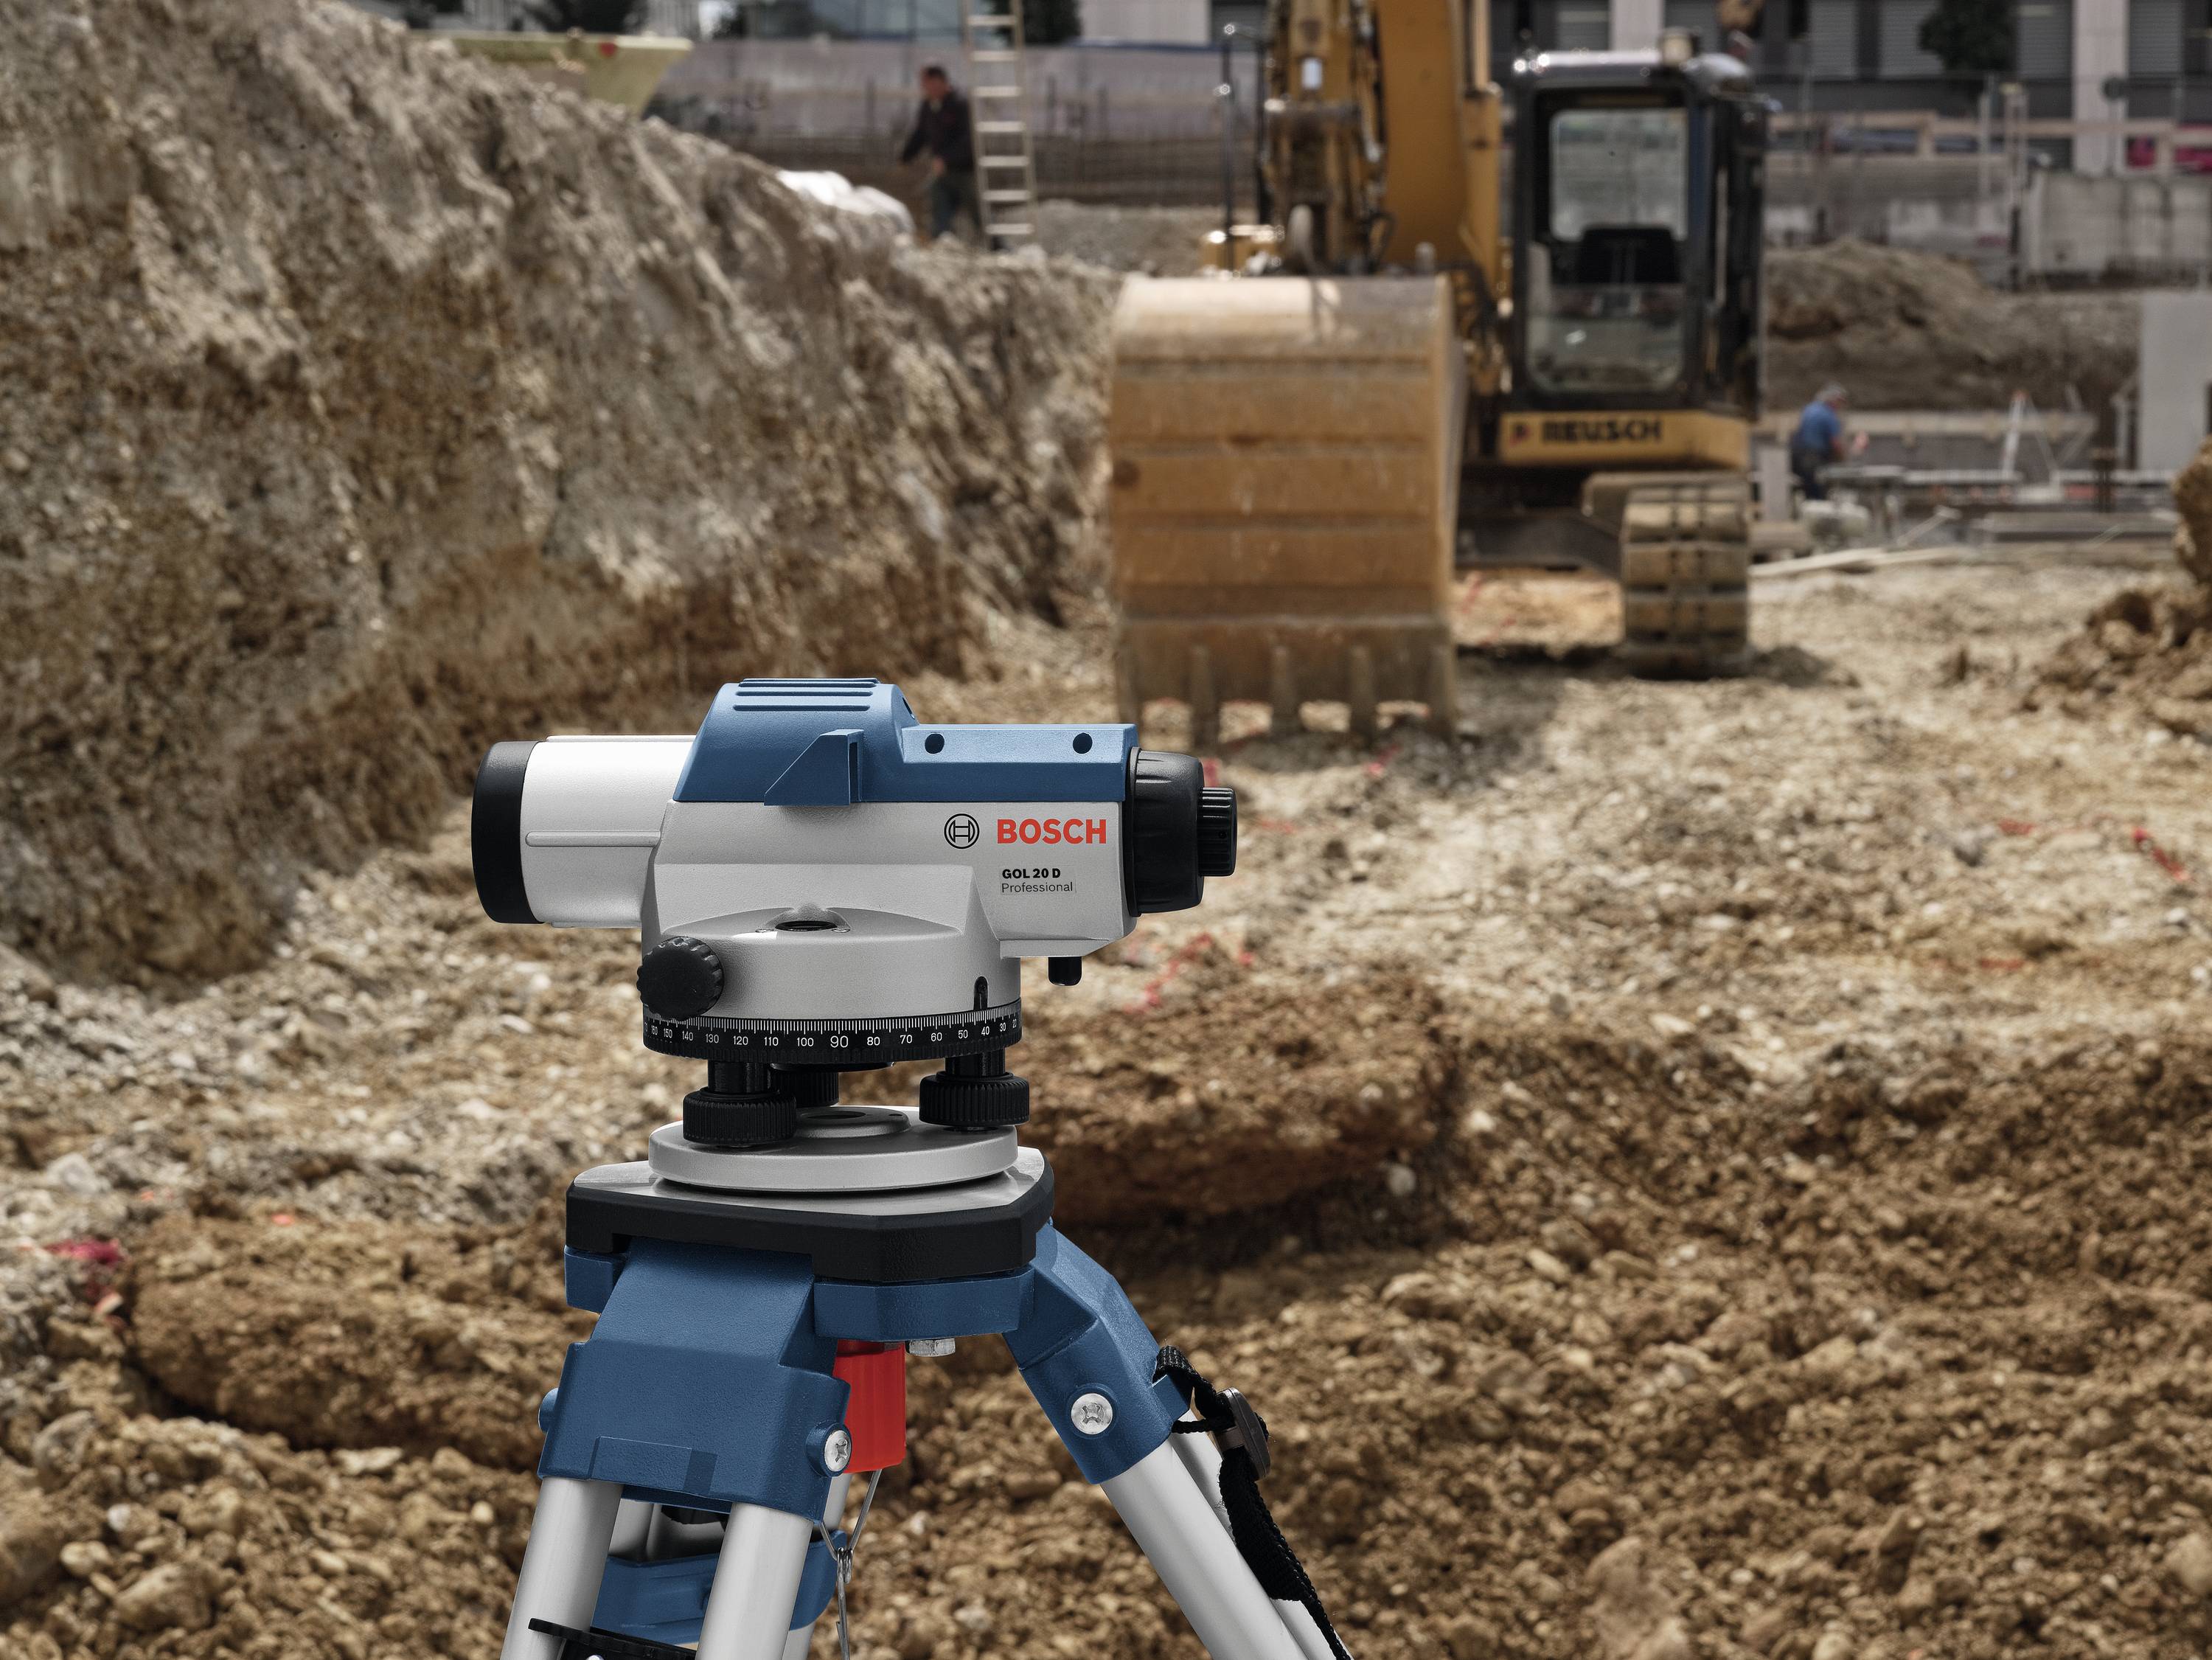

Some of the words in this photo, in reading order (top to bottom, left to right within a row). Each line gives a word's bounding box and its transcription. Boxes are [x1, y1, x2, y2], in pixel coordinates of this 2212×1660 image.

[997, 819, 1107, 844] BOSCH
[1002, 869, 1030, 879] GOL
[1033, 868, 1049, 879] 20
[1052, 868, 1061, 878] D
[1001, 881, 1074, 893] Professional
[663, 1028, 673, 1038] 150
[681, 1030, 694, 1042] 140
[706, 1033, 719, 1044] 130
[732, 1035, 748, 1046] 120
[763, 1036, 779, 1046] 110
[796, 1037, 814, 1047] 100
[830, 1035, 849, 1048] 90
[866, 1036, 880, 1046] 80
[900, 1034, 913, 1044] 70
[931, 1032, 942, 1042] 60
[957, 1029, 968, 1040] 50
[981, 1026, 990, 1036] 40
[999, 1022, 1006, 1032] 30
